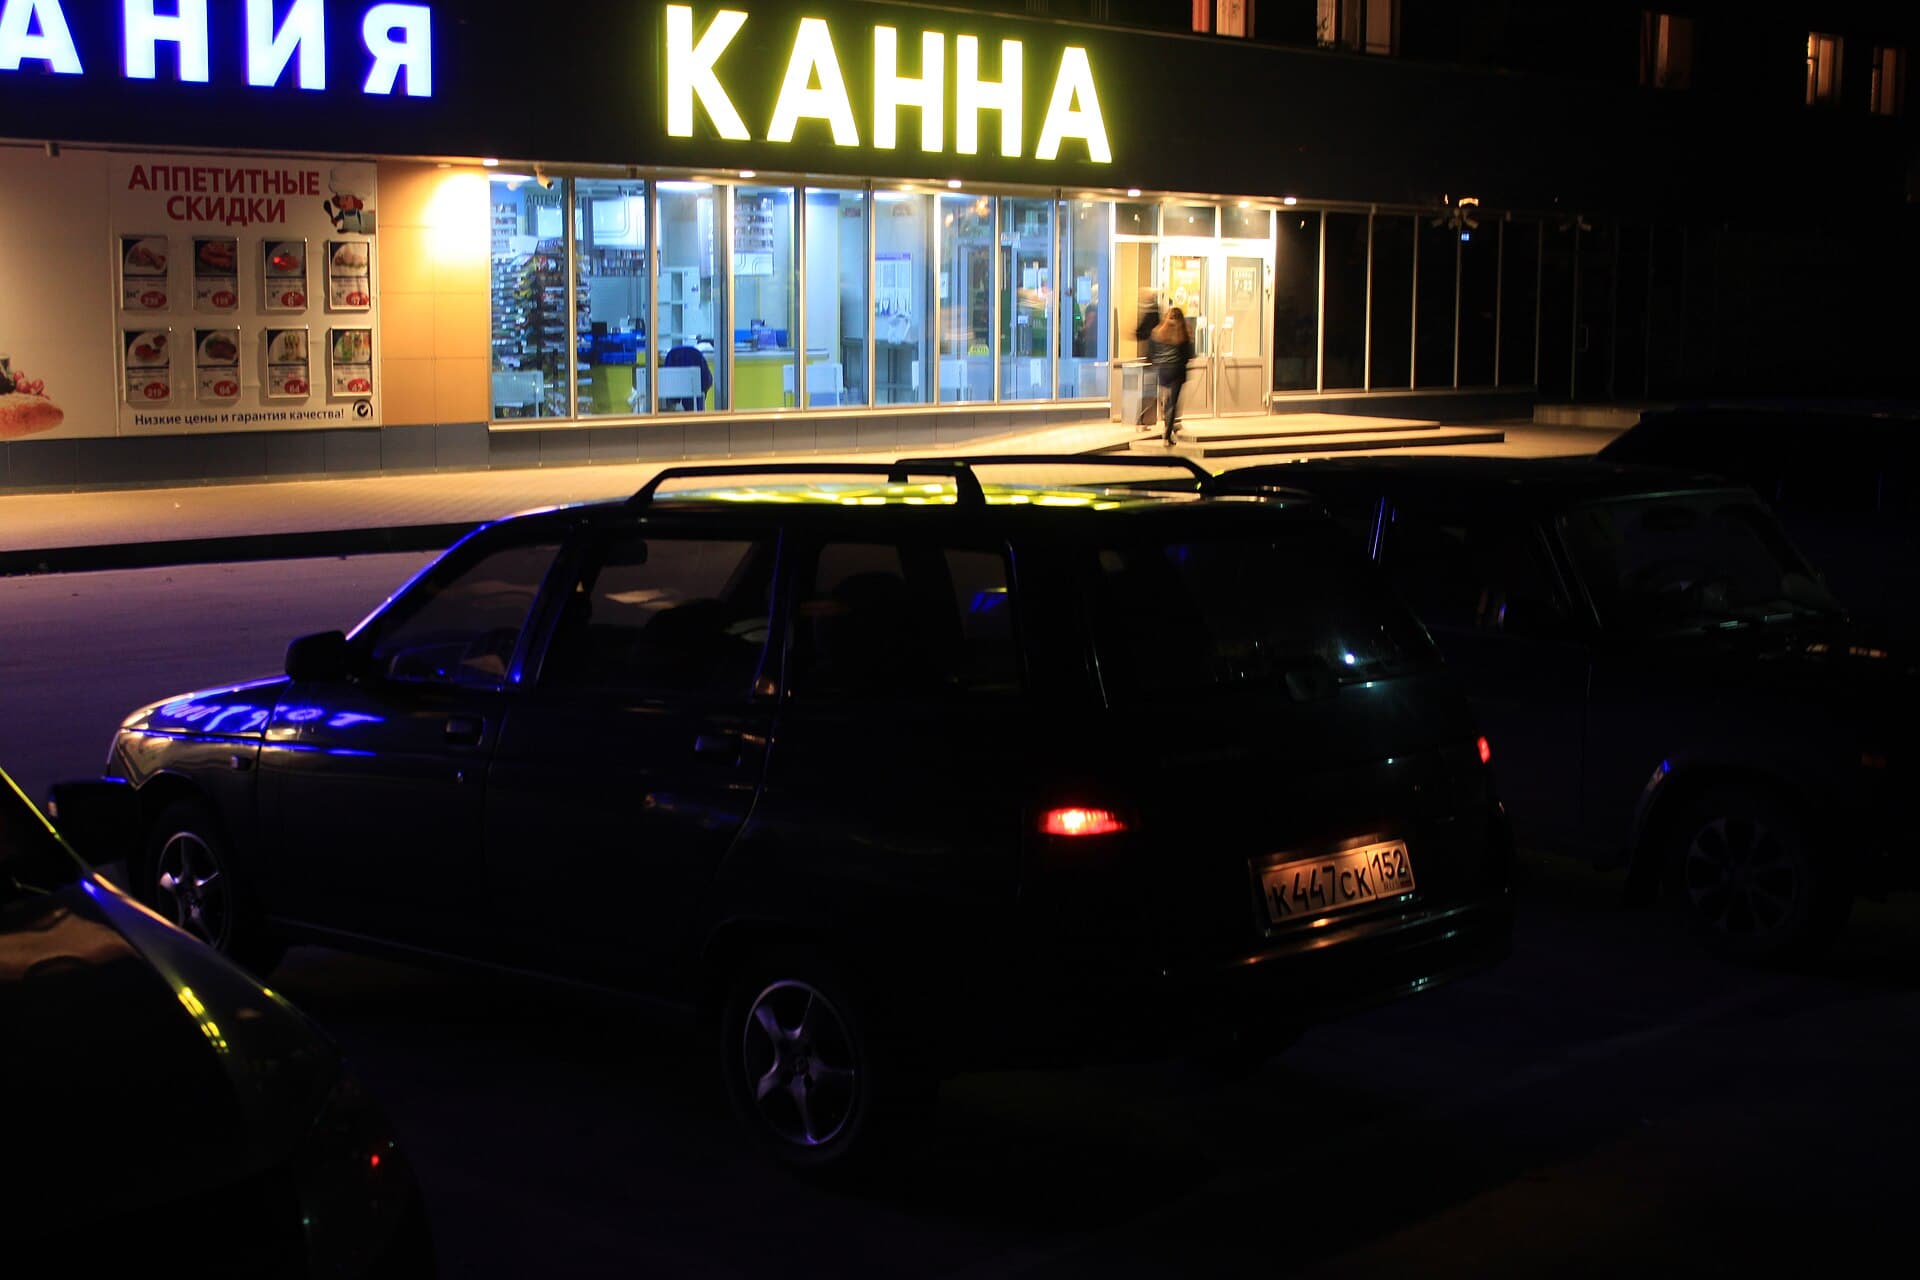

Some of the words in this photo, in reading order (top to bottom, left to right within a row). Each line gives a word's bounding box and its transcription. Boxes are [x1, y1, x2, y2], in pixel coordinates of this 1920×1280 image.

[666, 3, 1113, 164] КАННА
[128, 164, 320, 196] АППЕТИТНЫЕ
[166, 195, 286, 226] СКИДКИ
[135, 413, 182, 426] Низкие
[185, 412, 218, 425] цены
[221, 413, 229, 423] и
[231, 411, 287, 424] гарантия
[289, 408, 345, 421] качества!
[1271, 866, 1373, 917] К447СК
[1372, 848, 1407, 883] 152
